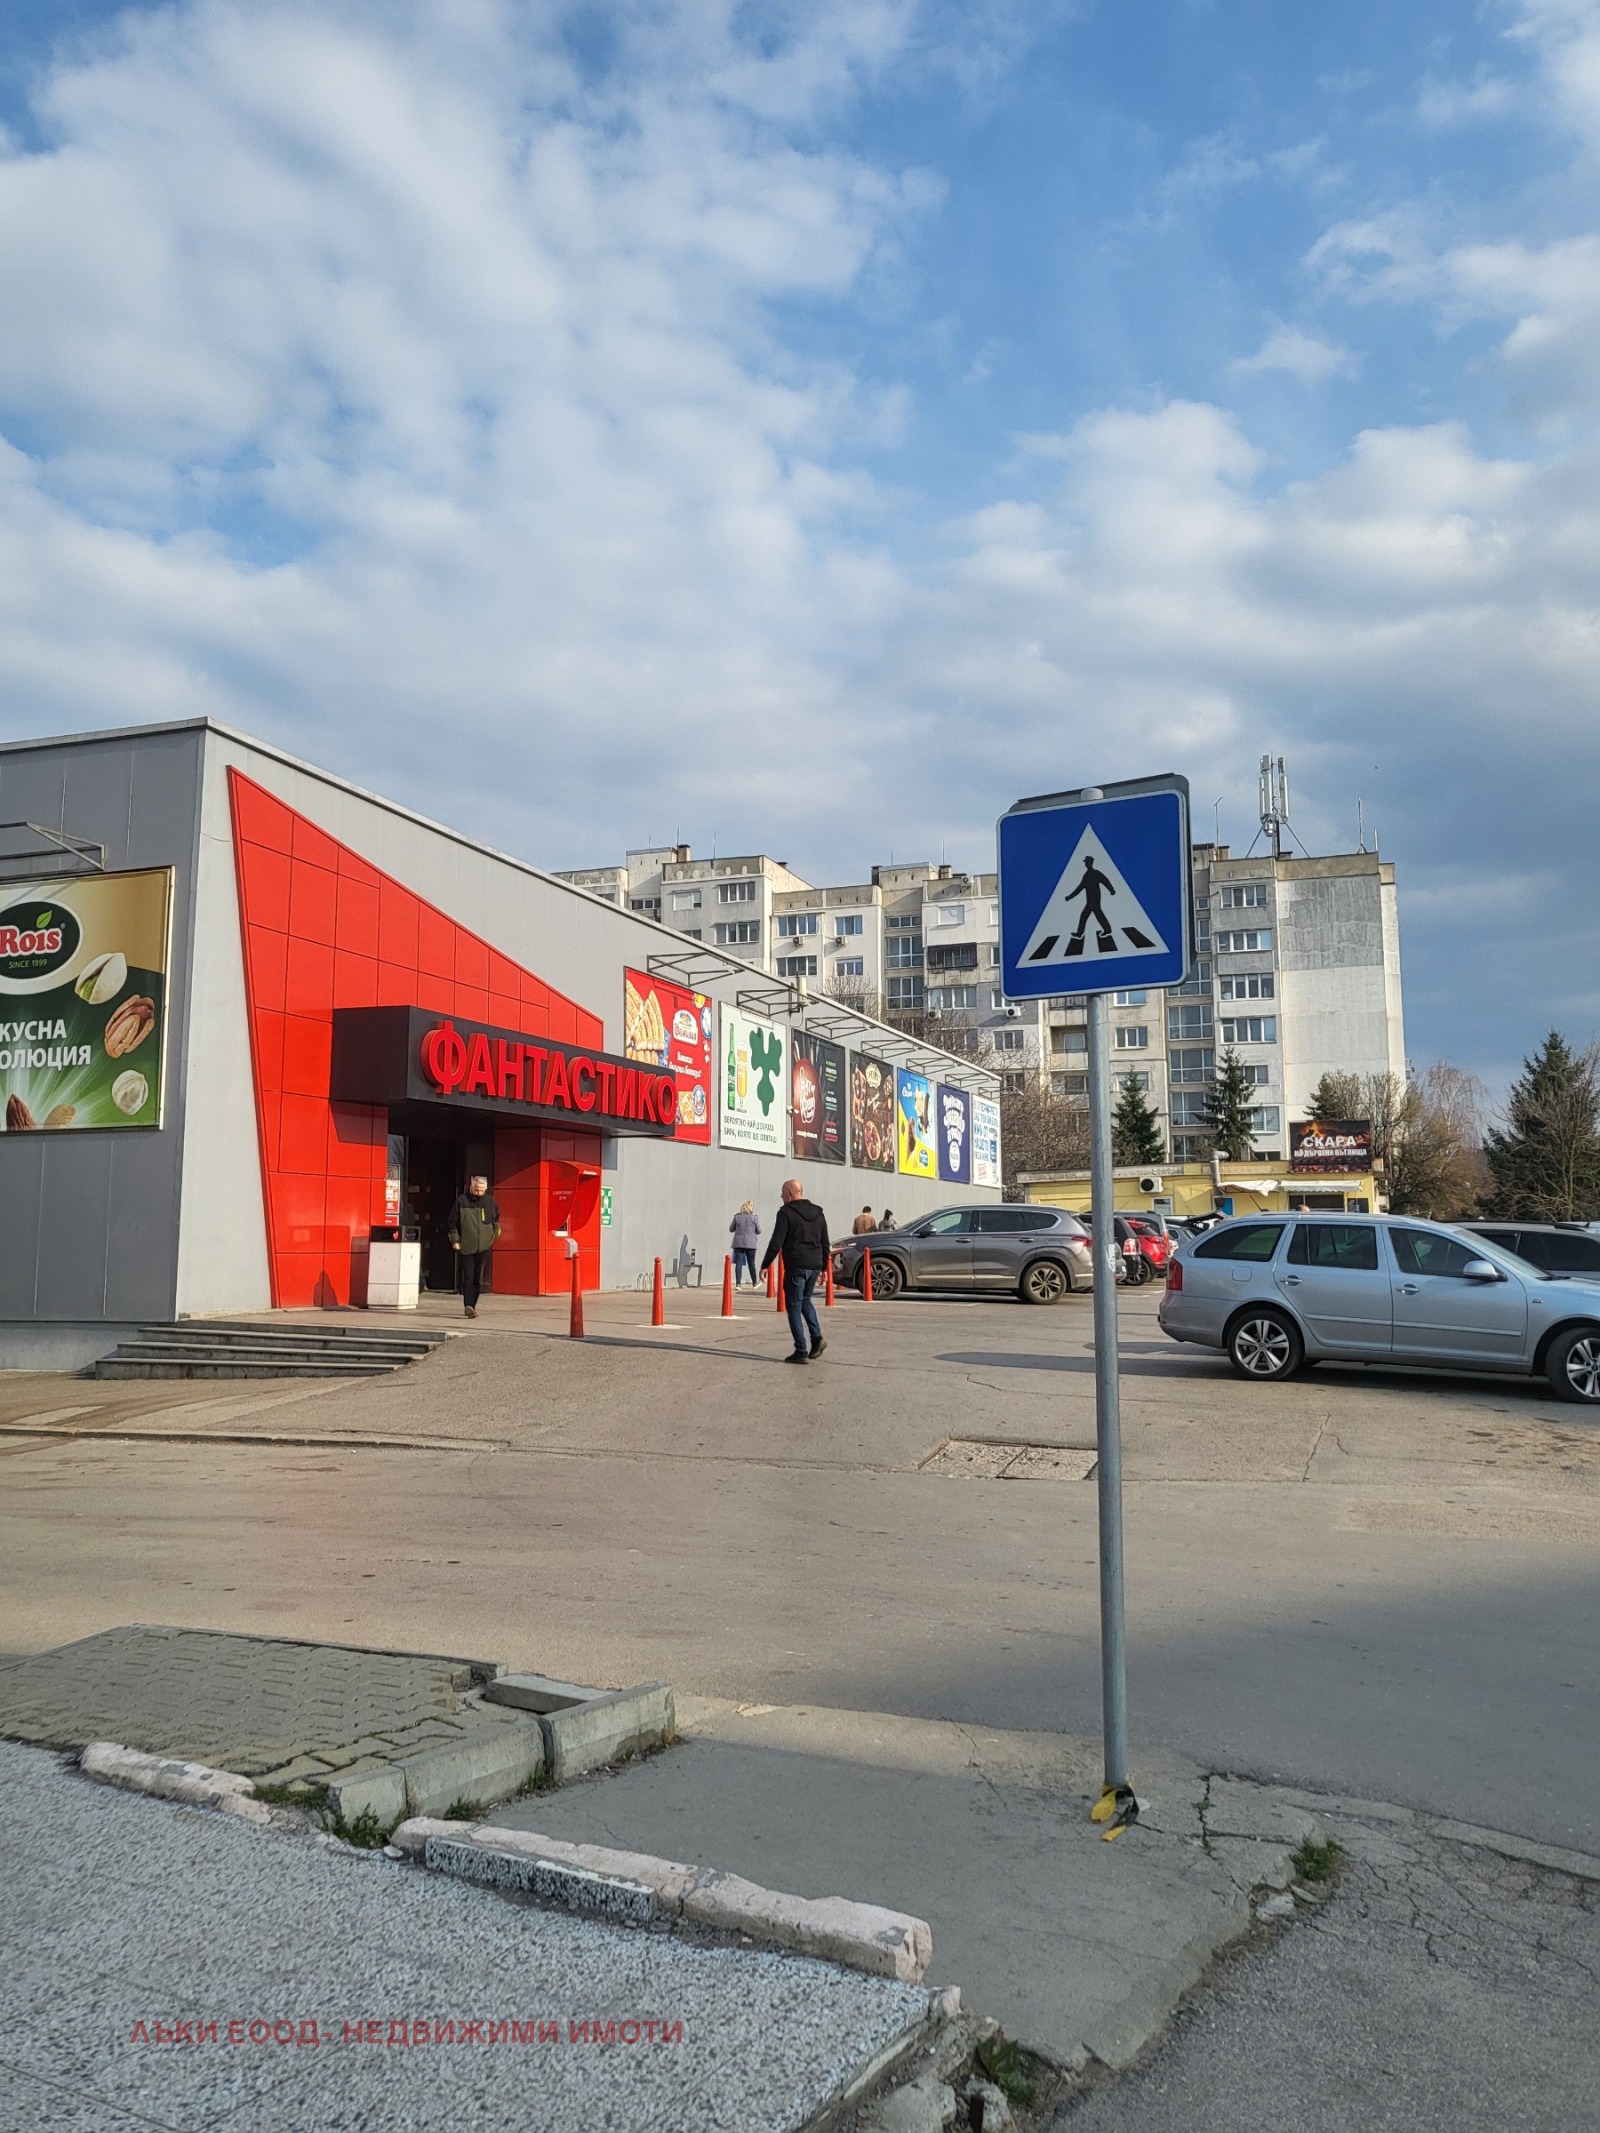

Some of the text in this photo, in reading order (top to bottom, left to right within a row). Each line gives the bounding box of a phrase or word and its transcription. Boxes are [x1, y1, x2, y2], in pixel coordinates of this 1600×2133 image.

[8, 958, 48, 969] SINCE 1999
[421, 1020, 677, 1126] ФАНТАСТИКО
[724, 1115, 746, 1126] ВЕРОЯТНО
[1303, 1135, 1357, 1148] СКАРА
[1334, 1148, 1367, 1157] ВЪГЛИЩА
